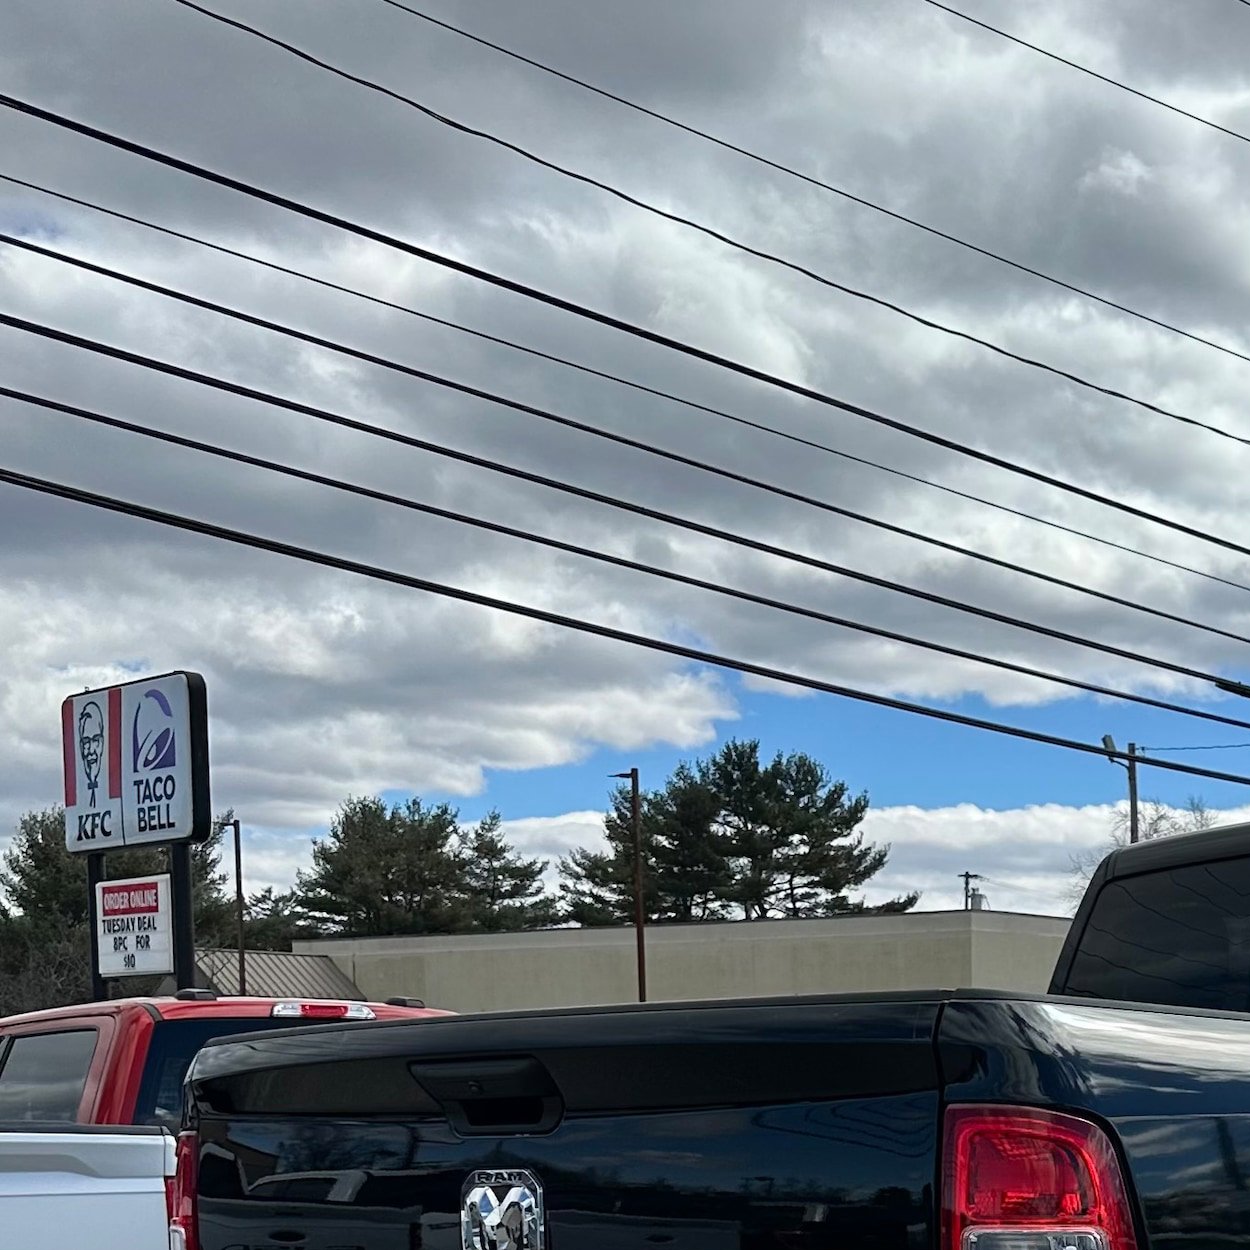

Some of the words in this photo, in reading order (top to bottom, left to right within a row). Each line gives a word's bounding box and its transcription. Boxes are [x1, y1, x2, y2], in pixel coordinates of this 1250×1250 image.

[133, 775, 176, 804] TACO
[77, 810, 112, 841] KFC
[137, 803, 176, 832] BELL
[104, 891, 129, 910] ORDER
[130, 889, 157, 908] ONLINE
[102, 917, 135, 934] TUESDAY
[137, 916, 157, 931] DEAL
[135, 935, 151, 950] FOR
[475, 1172, 524, 1185] RAM
